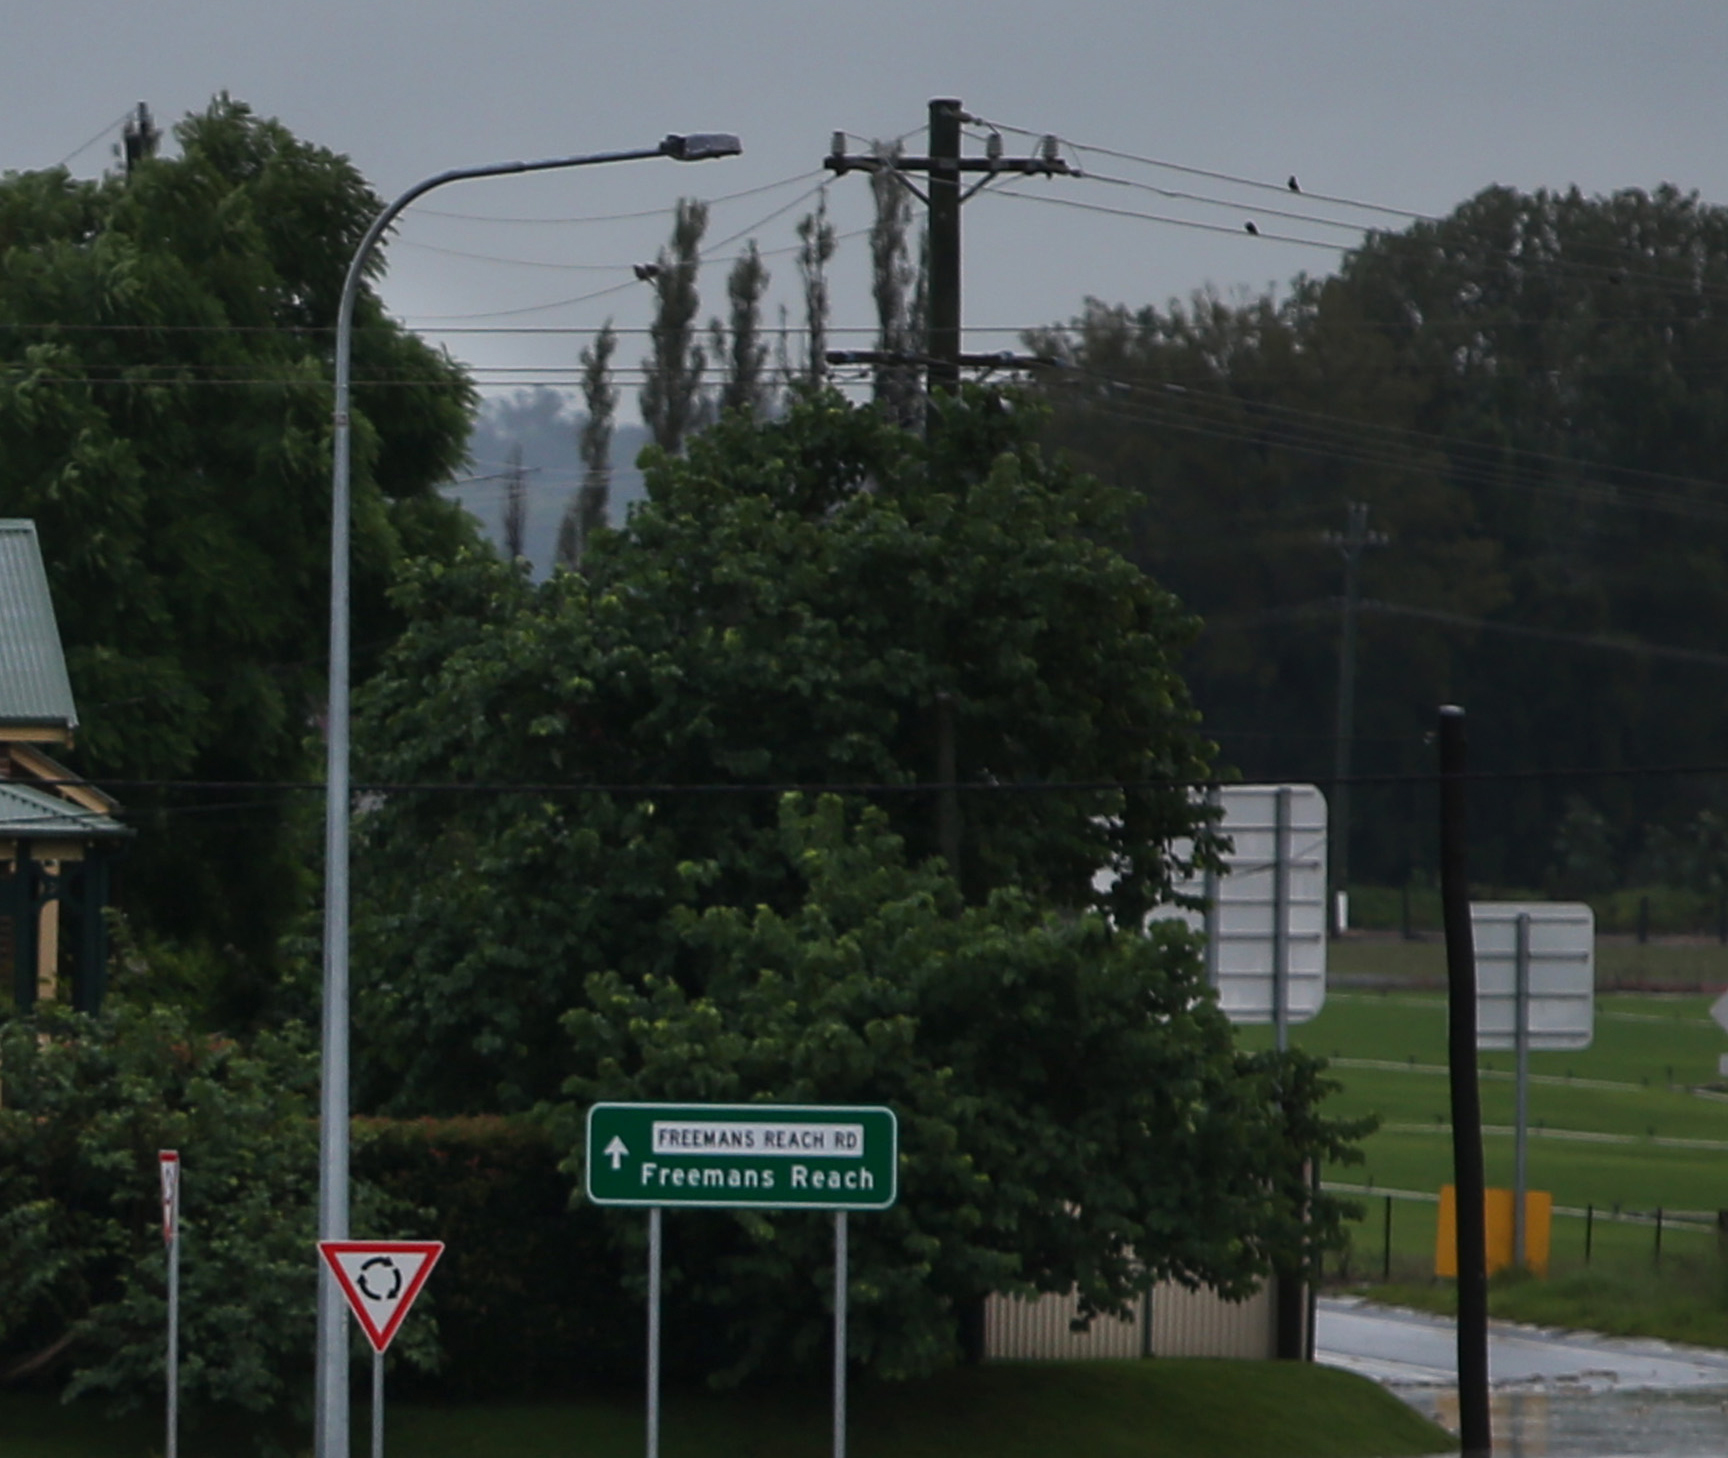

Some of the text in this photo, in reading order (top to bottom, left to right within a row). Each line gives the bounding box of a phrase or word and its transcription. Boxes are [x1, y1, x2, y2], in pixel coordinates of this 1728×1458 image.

[658, 1128, 858, 1150] FREEMANS REACH RD
[641, 1162, 874, 1189] Freemans Reach
